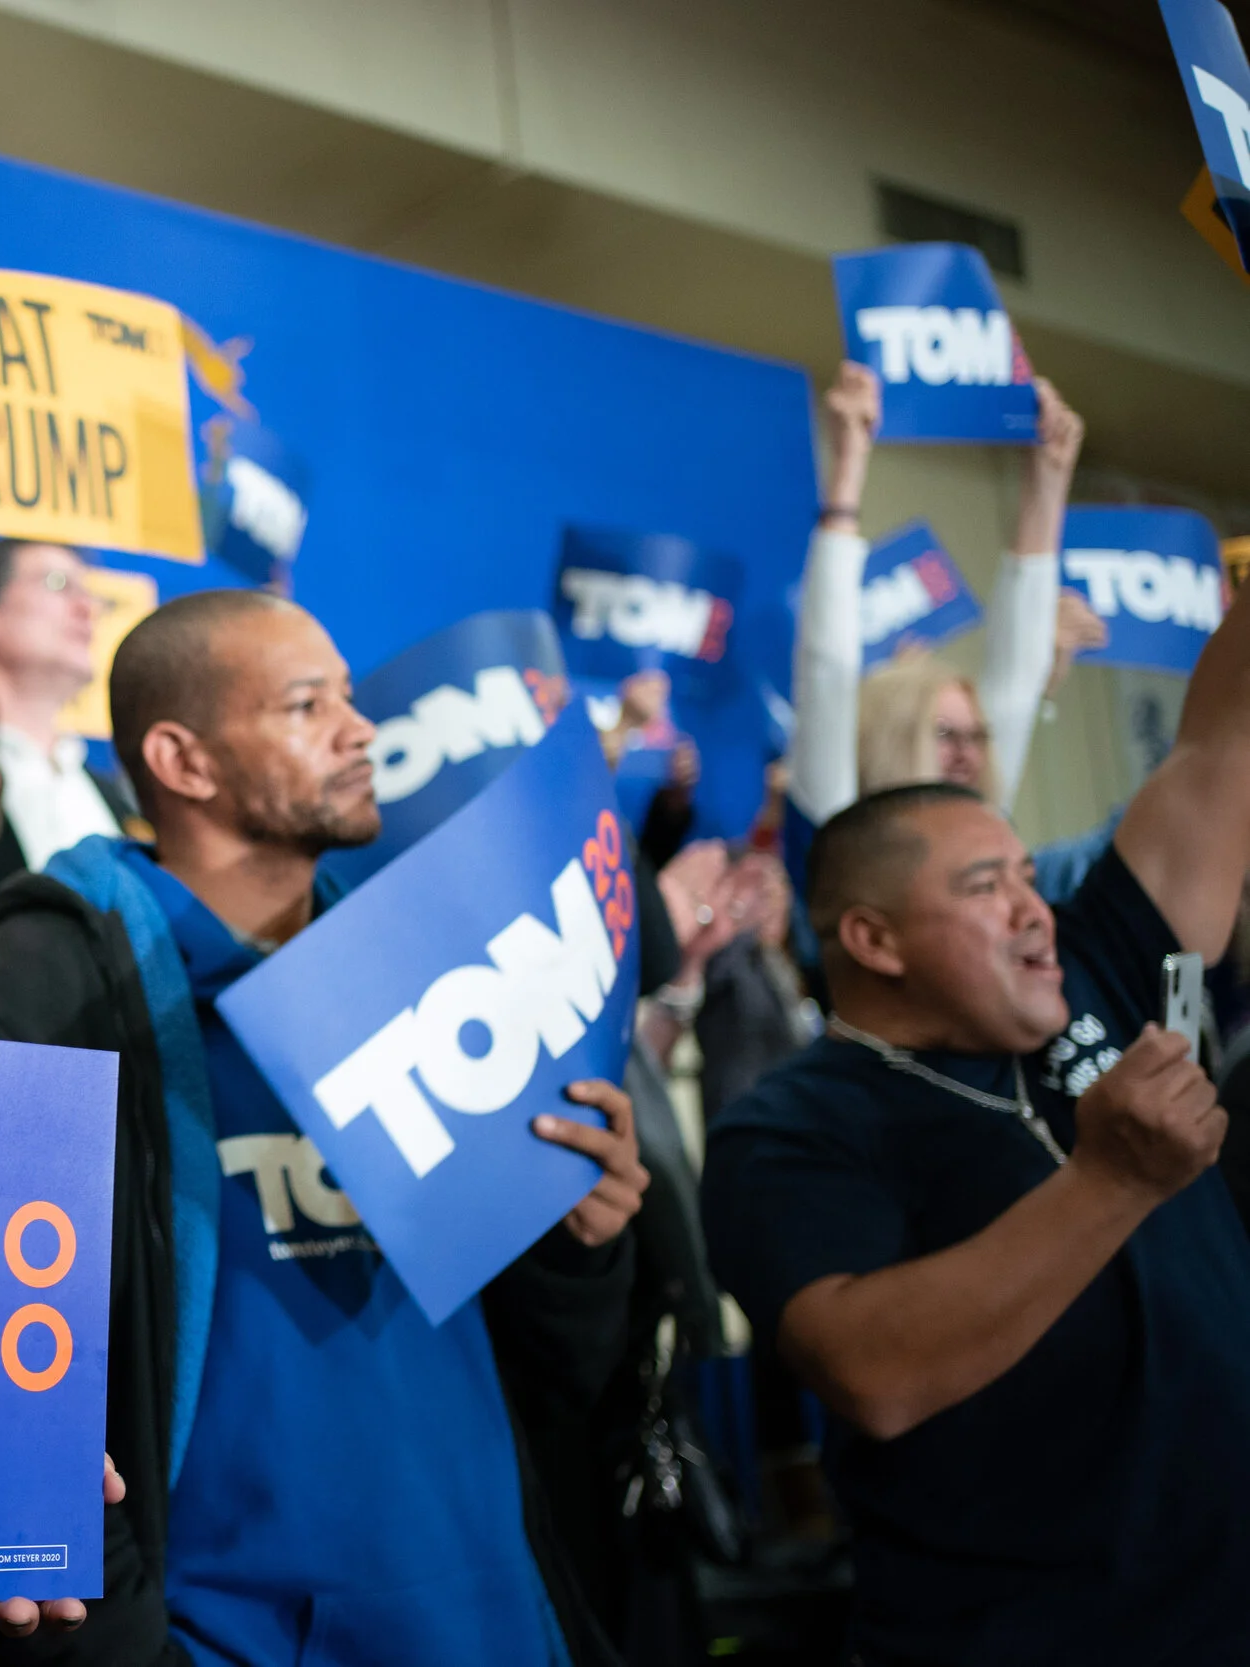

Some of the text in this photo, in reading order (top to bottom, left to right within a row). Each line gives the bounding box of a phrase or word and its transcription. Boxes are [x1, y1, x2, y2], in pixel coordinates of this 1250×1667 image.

[855, 304, 1013, 388] TOM
[560, 565, 713, 660] TOM
[1063, 547, 1223, 635] TOM
[312, 857, 618, 1180] TOM
[13, 1553, 40, 1562] STEYER
[42, 1553, 61, 1562] 2020
